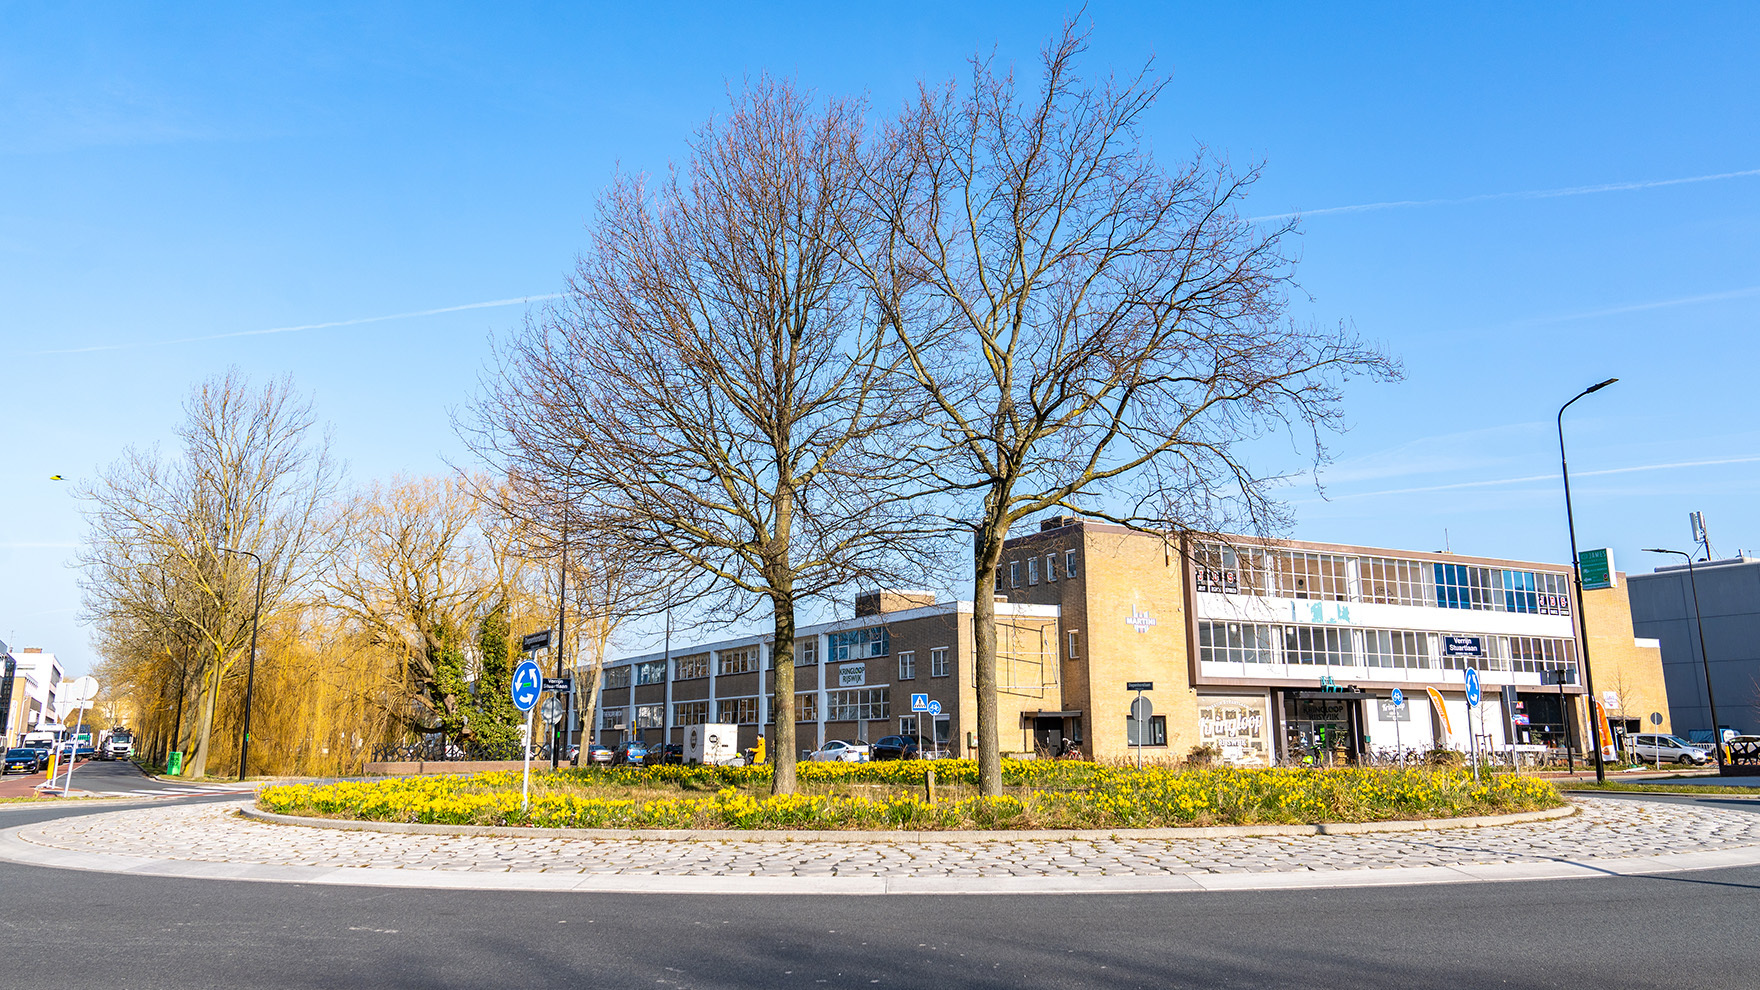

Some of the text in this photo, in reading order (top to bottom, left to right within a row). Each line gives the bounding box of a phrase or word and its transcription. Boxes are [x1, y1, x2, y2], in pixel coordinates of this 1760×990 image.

[1126, 617, 1156, 626] MARTINI
[1453, 637, 1472, 645] Verrijn
[839, 667, 865, 675] KRINGLOOP
[843, 675, 862, 684] RIJSWIJK
[1198, 713, 1263, 737] Kringloop
